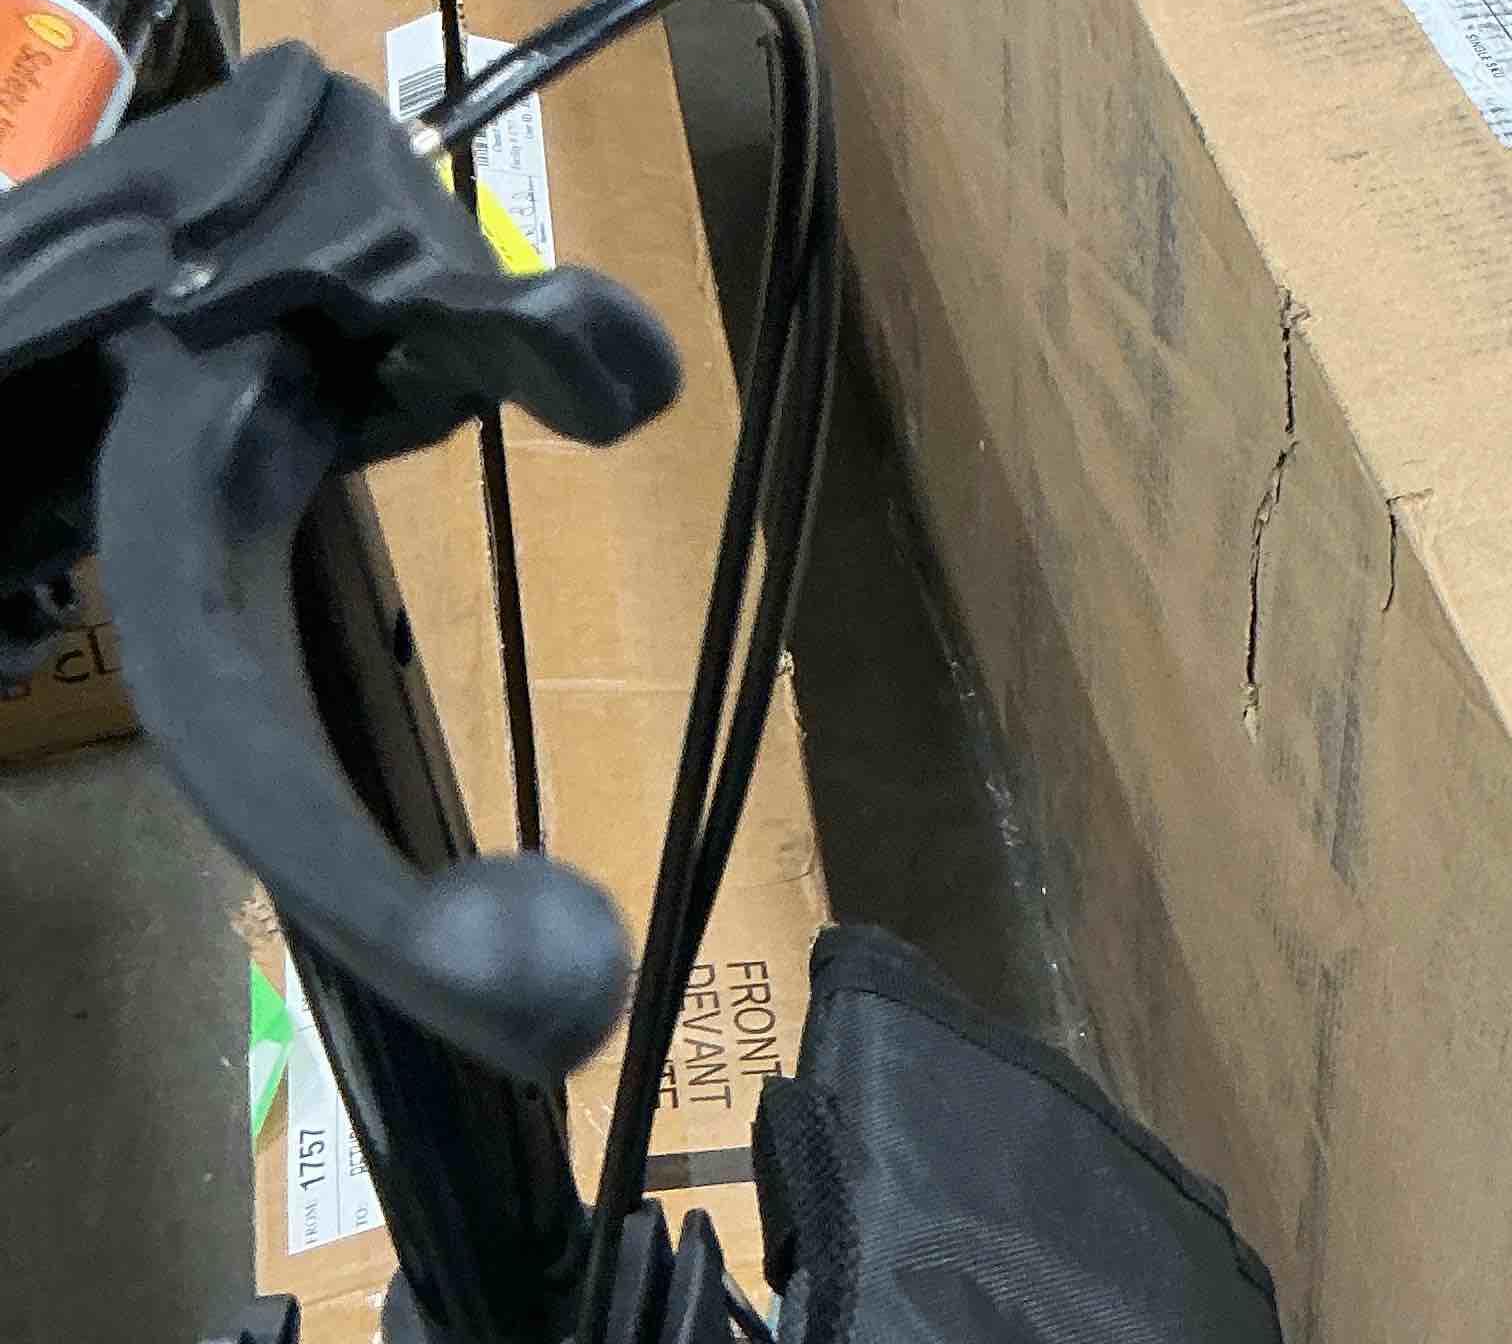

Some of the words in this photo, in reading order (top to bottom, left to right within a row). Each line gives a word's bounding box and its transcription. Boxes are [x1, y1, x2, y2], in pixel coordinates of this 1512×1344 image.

[682, 964, 731, 1109] DEVANT
[727, 960, 782, 1077] FRONT
[299, 1129, 325, 1191] 1757
